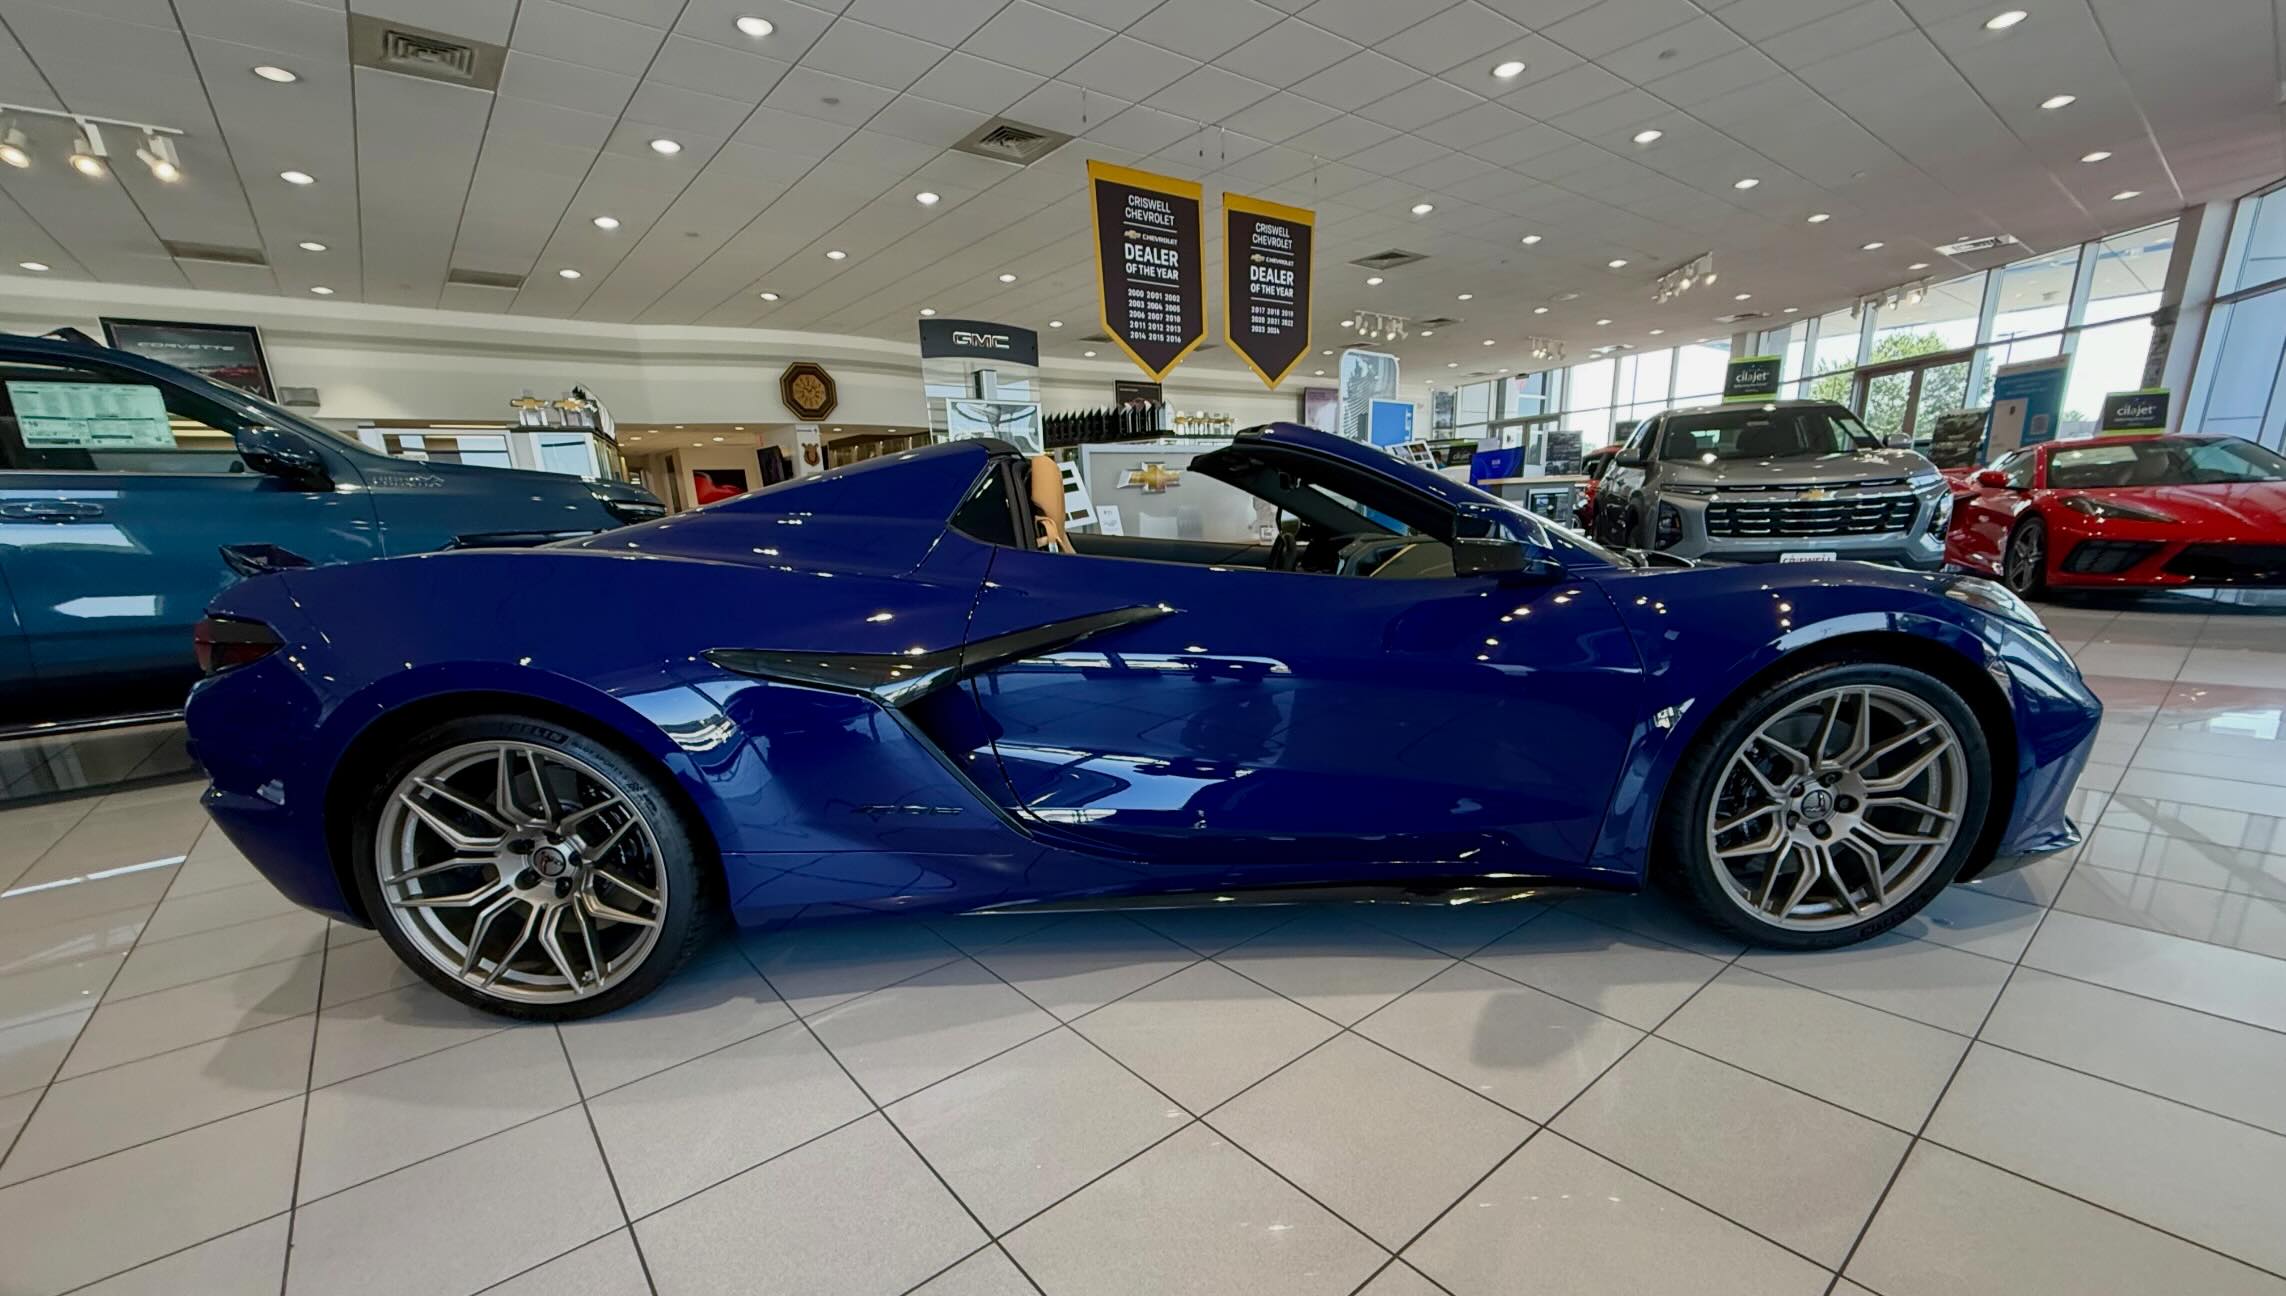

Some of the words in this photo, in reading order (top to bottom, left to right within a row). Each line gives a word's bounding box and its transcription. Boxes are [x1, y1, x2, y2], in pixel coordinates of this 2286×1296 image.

[1128, 194, 1171, 213] CRISWELL
[1125, 207, 1175, 226] CHEVROLET
[1255, 222, 1290, 238] CRISWELL
[1142, 233, 1178, 245] CHEVROLET
[1252, 233, 1293, 249] CHEVROLET
[1124, 242, 1179, 267] DEALER
[1125, 262, 1138, 274] OF
[1138, 264, 1156, 277] THE
[1156, 267, 1179, 280] YEAR
[1250, 265, 1294, 286] DEALER
[1128, 288, 1144, 298] 2000
[1146, 290, 1162, 300] 2001
[1164, 293, 1180, 302] 2002
[1250, 283, 1260, 293] OF
[1261, 284, 1275, 295] THE
[1276, 286, 1294, 298] YEAR
[1128, 299, 1145, 308] 2003
[1147, 301, 1163, 310] 2004
[1129, 310, 1145, 319] 2006
[1147, 312, 1163, 321] 2007
[1165, 314, 1181, 323] 2010
[1130, 320, 1146, 329] 2011
[1148, 322, 1163, 331] 2012
[1166, 324, 1181, 333] 2013
[952, 331, 1010, 349] GMC
[1130, 331, 1146, 340] 2014
[1148, 333, 1164, 342] 2015
[1166, 335, 1181, 343] 2016
[137, 341, 235, 351] CORVETTE
